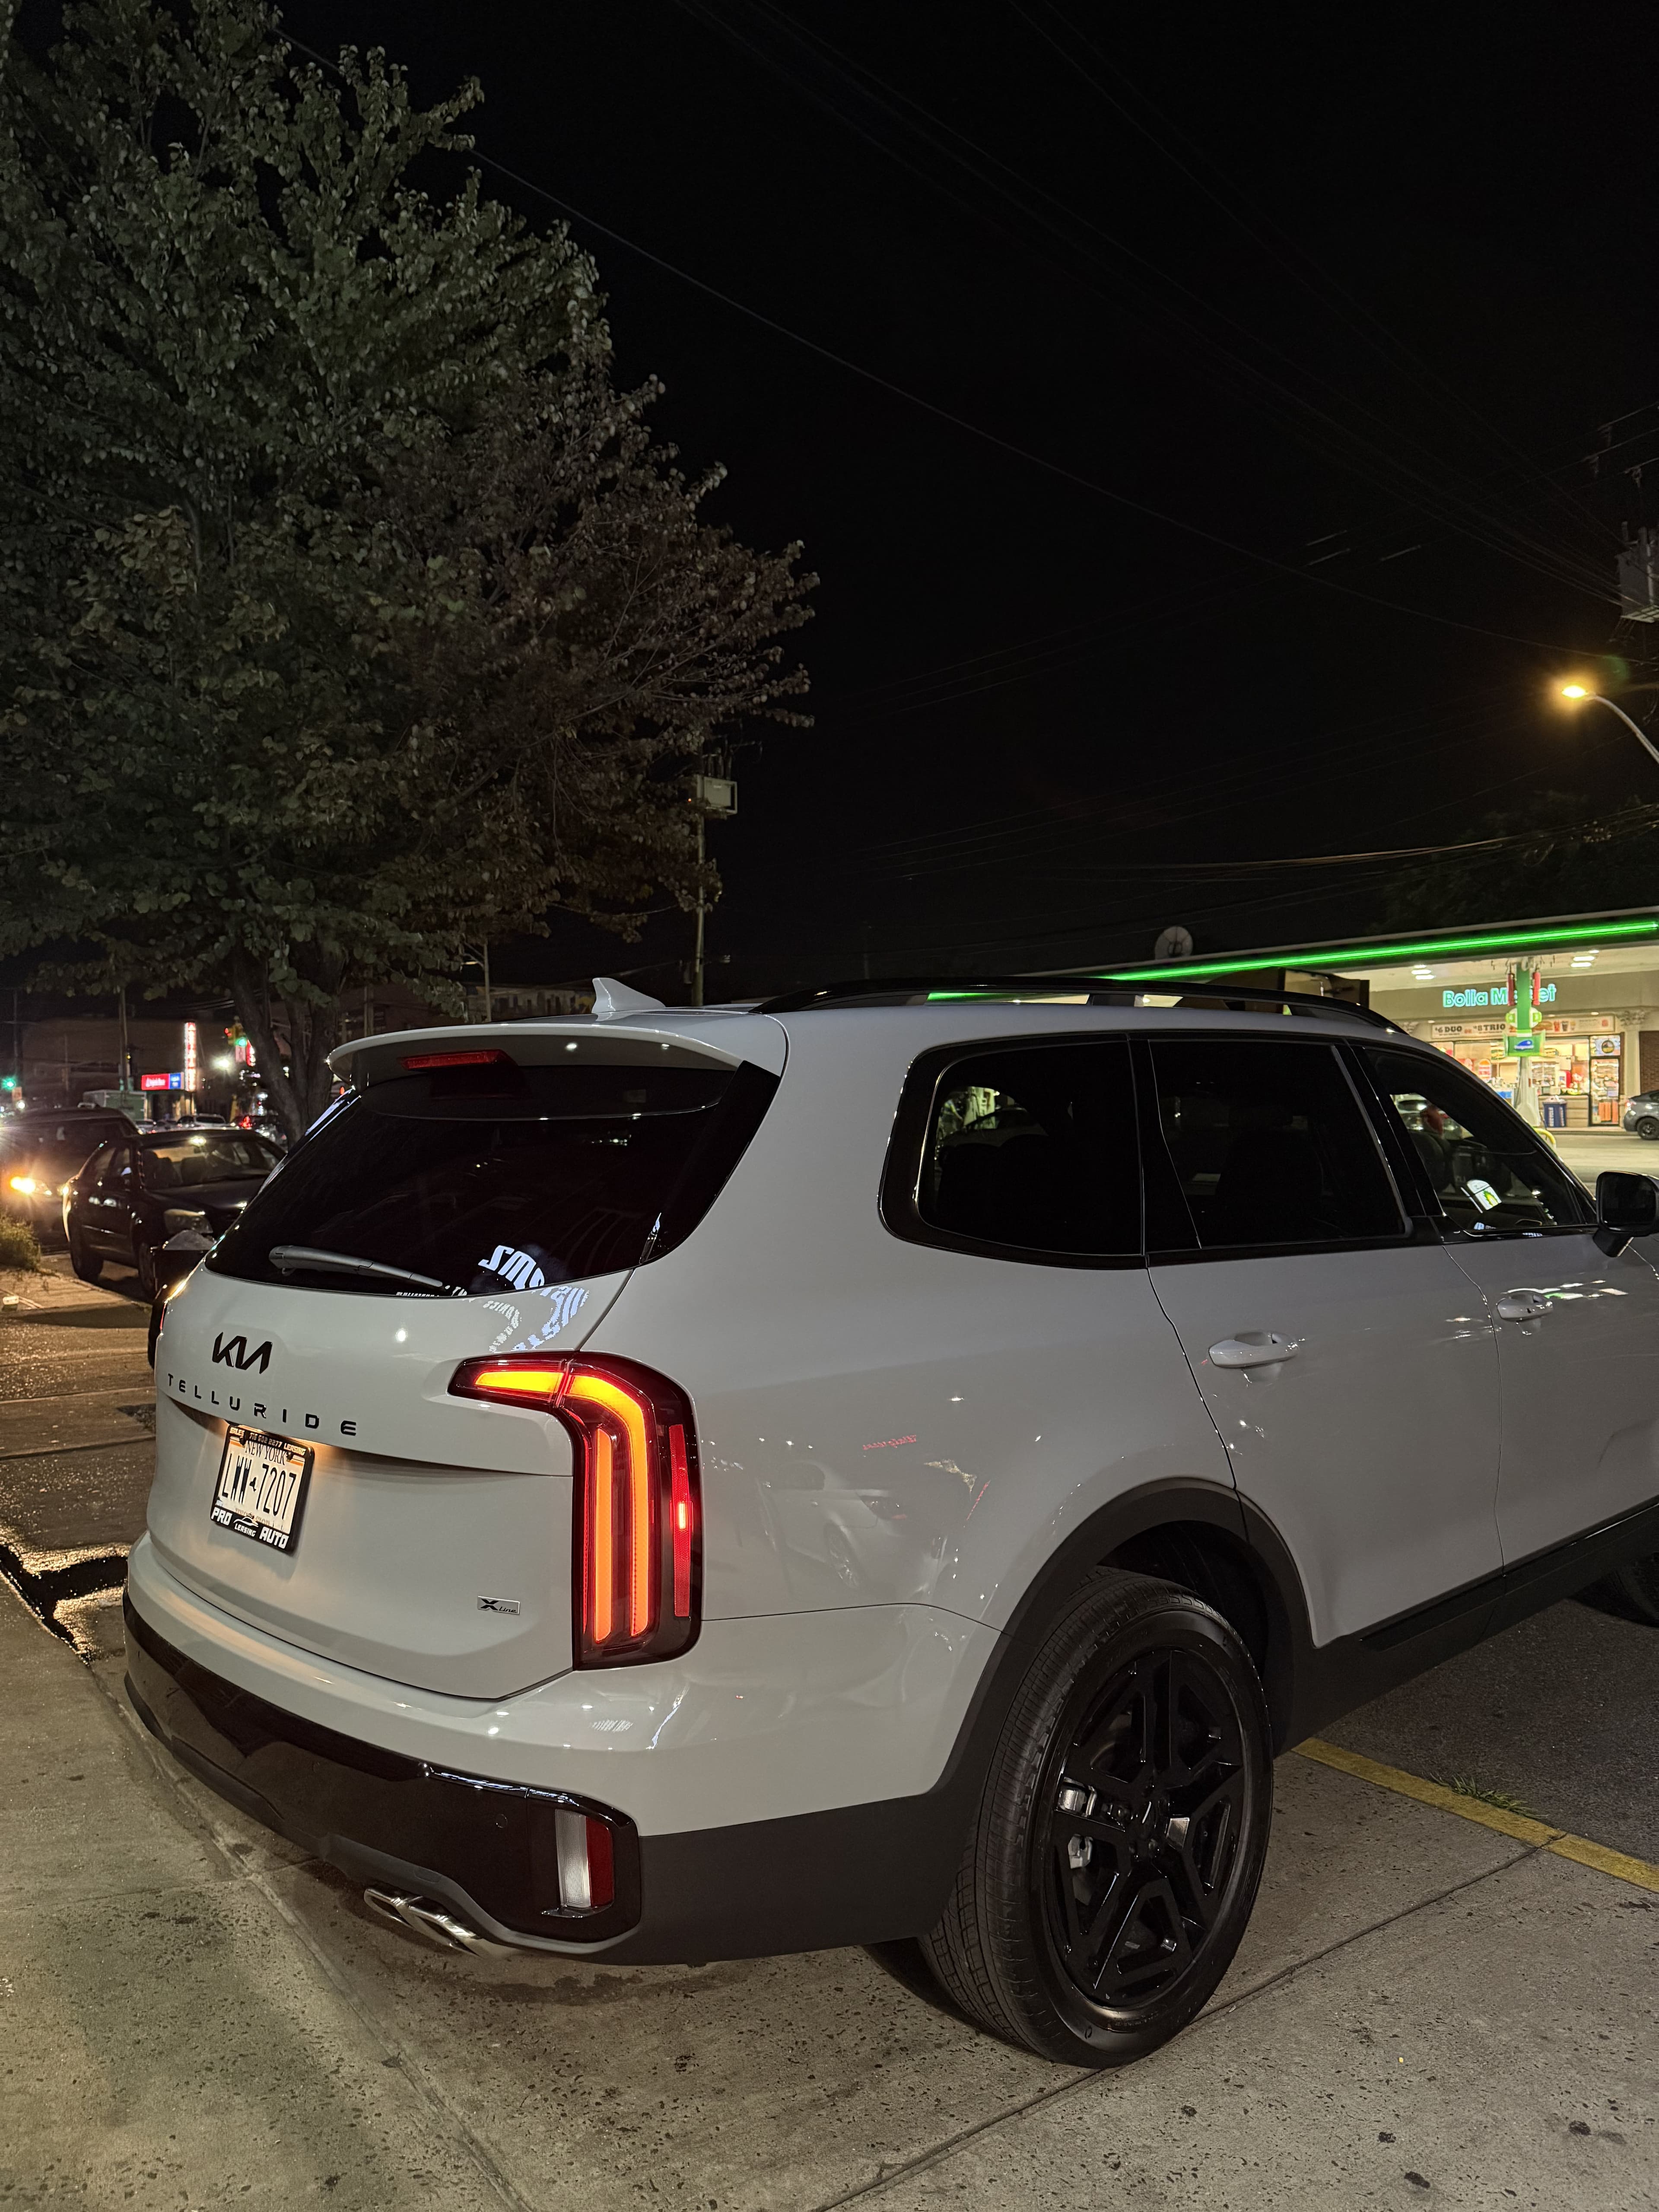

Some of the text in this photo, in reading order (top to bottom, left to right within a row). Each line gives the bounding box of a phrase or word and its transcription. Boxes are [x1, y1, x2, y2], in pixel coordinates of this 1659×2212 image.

[1443, 983, 1557, 1007] Bolla Met
[168, 1373, 357, 1436] TELLURIDE
[229, 1427, 245, 1437] SALES
[268, 1438, 283, 1448] 2277
[283, 1443, 306, 1456] LEASING
[245, 1440, 286, 1465] NEW YORK
[256, 1463, 297, 1520] 7207
[211, 1506, 233, 1526] PRO
[234, 1523, 257, 1537] LEASING
[259, 1526, 289, 1549] AUTO
